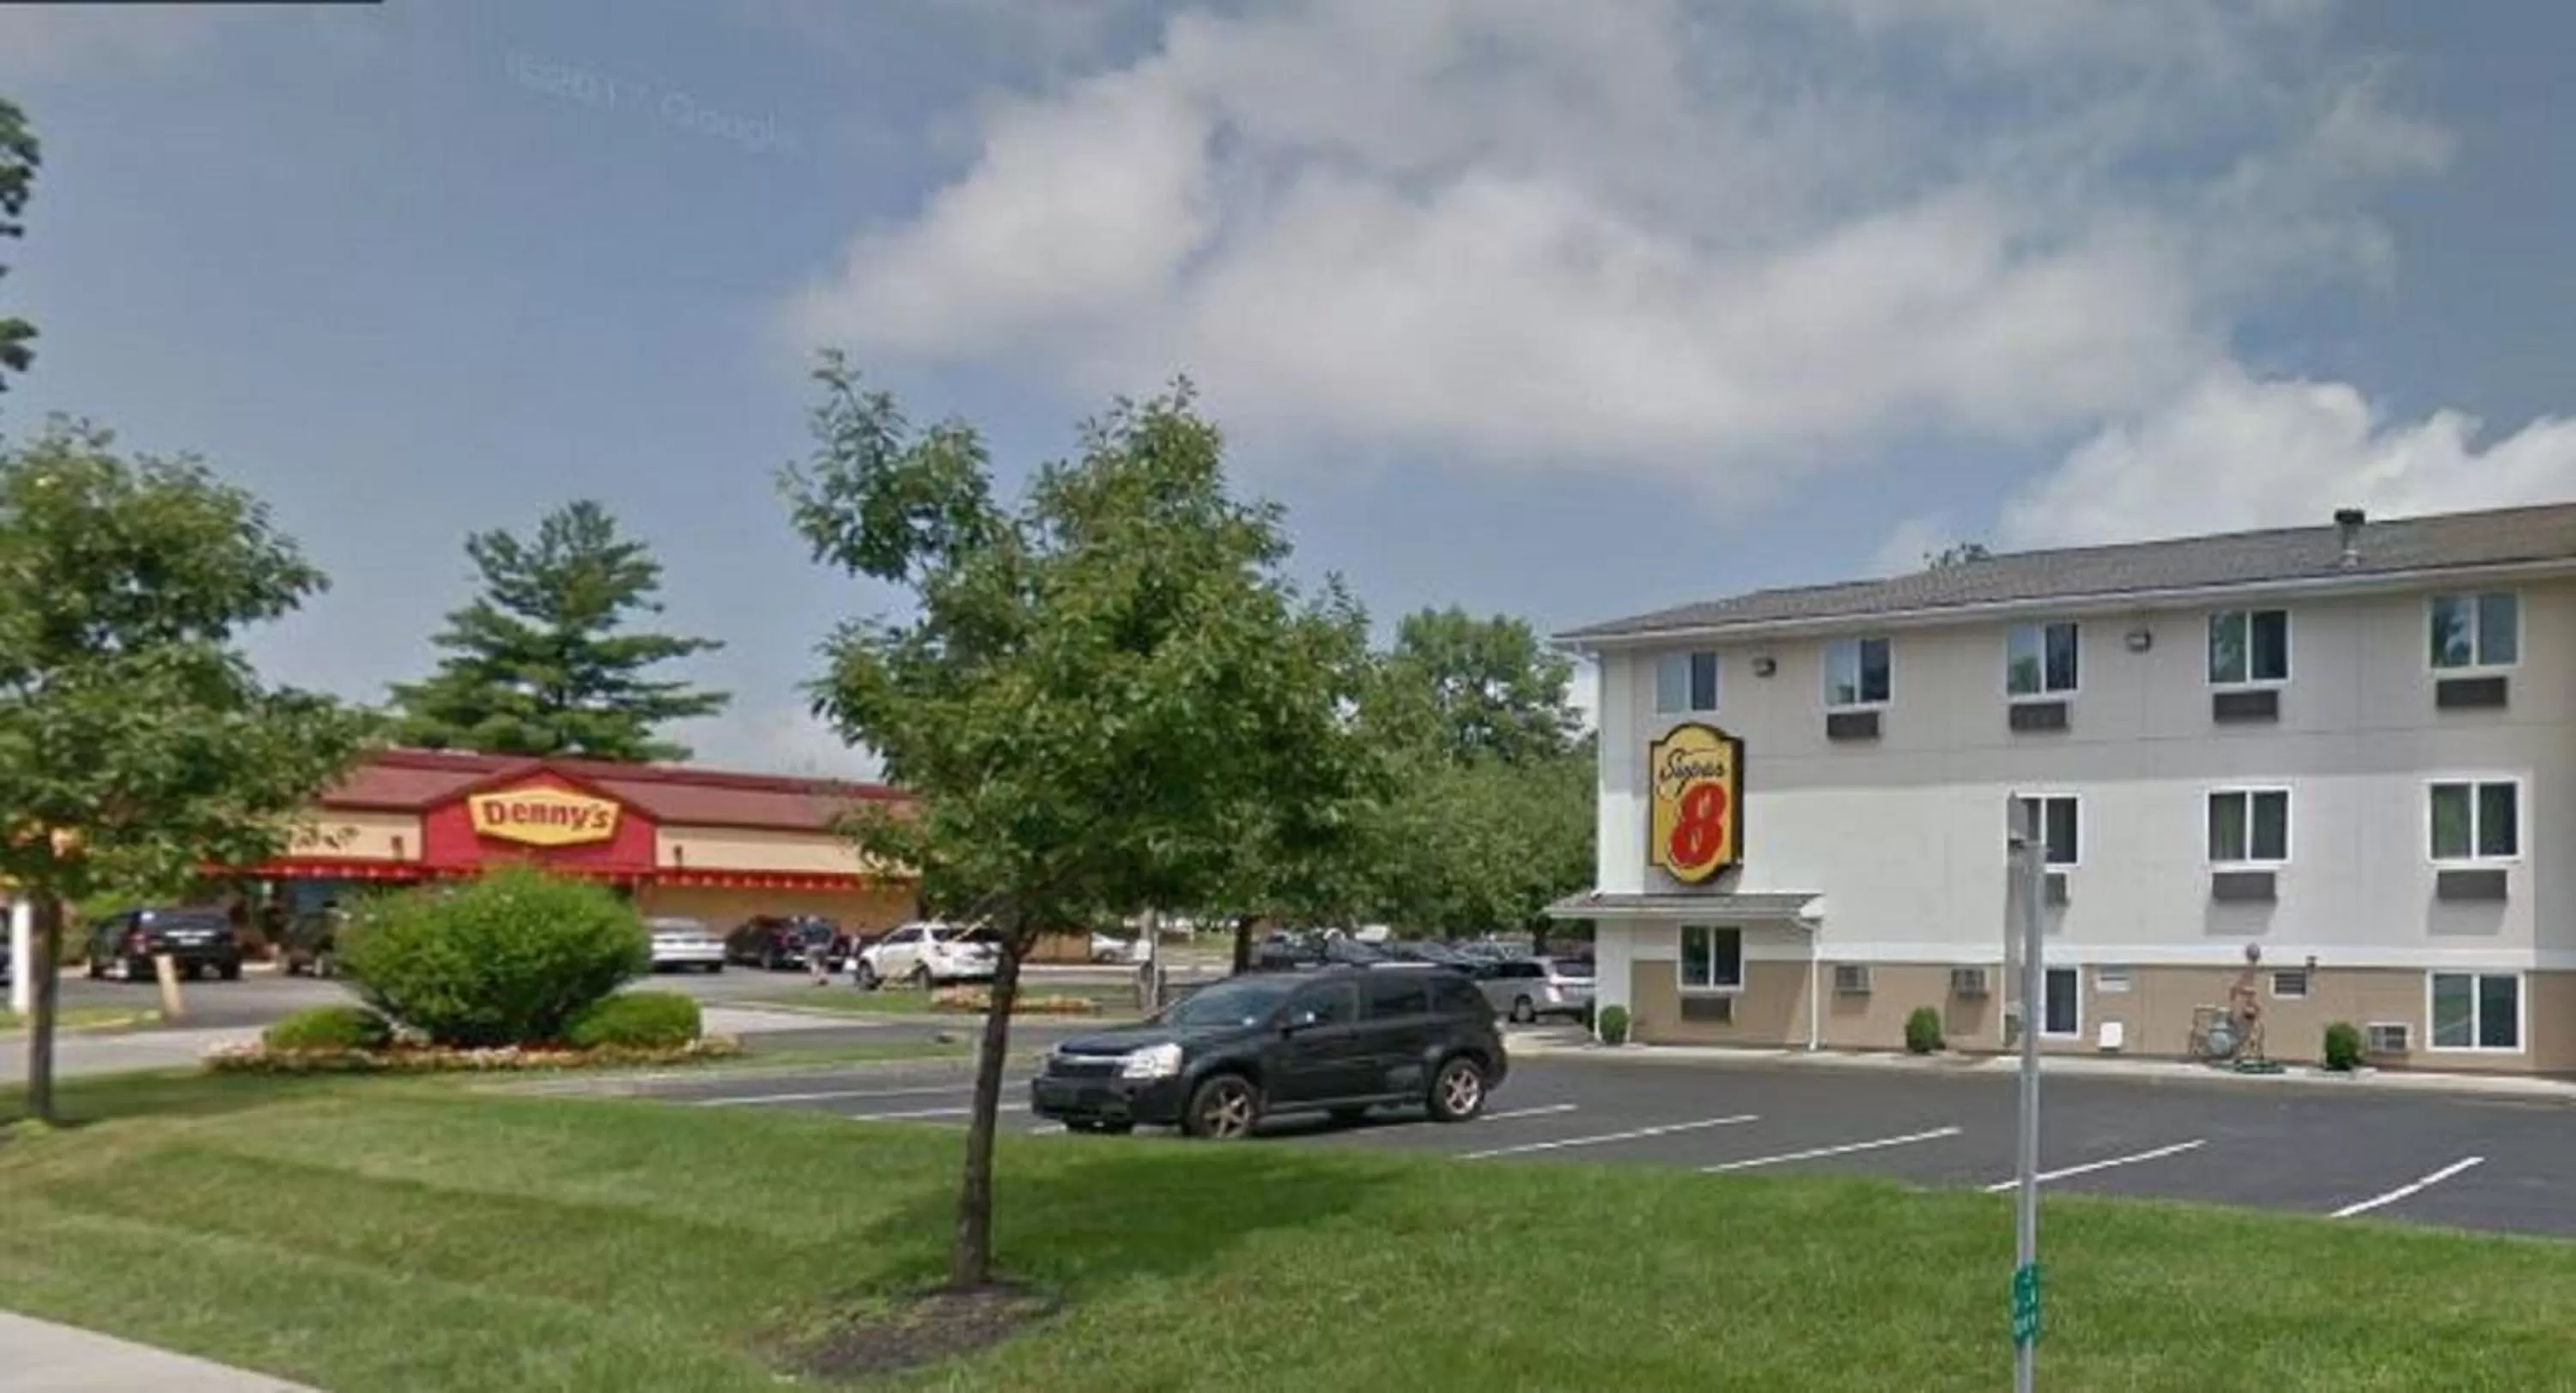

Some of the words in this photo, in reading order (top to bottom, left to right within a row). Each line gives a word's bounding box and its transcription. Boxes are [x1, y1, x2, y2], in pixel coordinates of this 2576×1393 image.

[1657, 748, 1726, 801] Super
[482, 800, 608, 830] Denny's
[1671, 782, 1727, 869] 8
